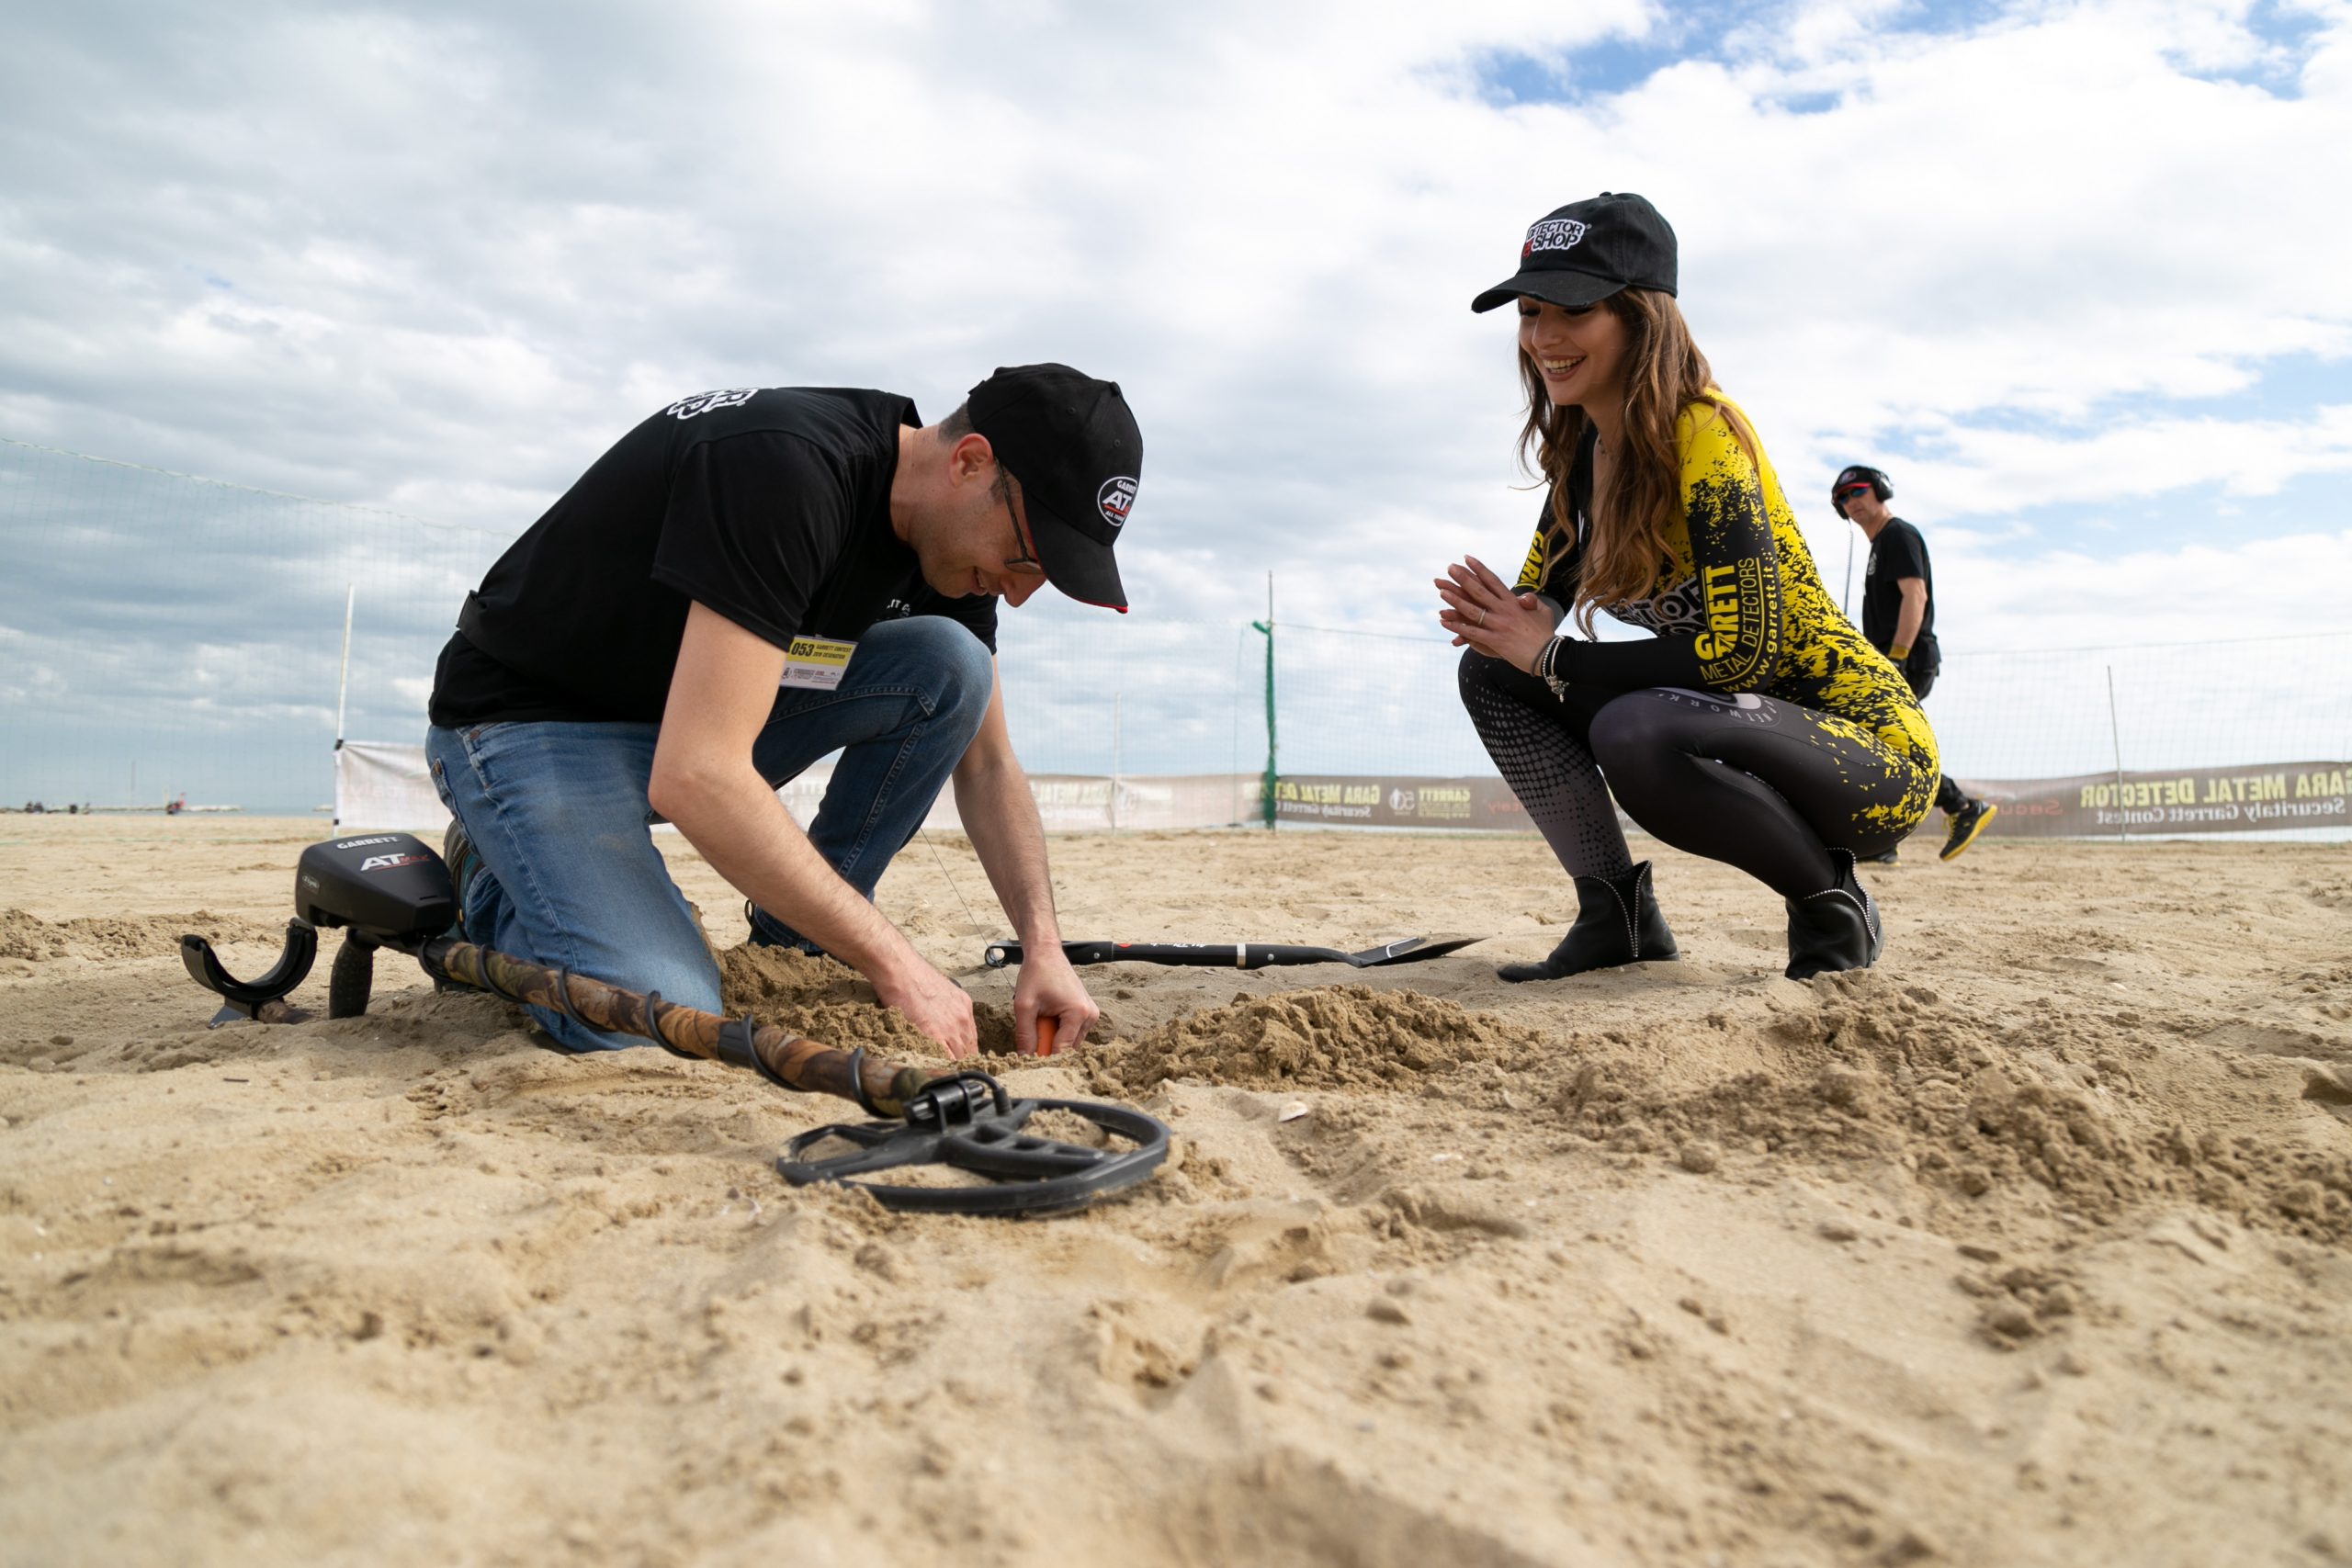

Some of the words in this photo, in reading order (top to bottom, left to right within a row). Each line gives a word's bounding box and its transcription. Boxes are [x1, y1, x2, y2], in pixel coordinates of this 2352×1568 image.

[1532, 232, 1578, 249] SHOP
[1102, 491, 1132, 511] AT
[1737, 557, 1759, 649] DETECTORS
[1723, 564, 1779, 694] www.garrett.it
[790, 642, 815, 657] 053
[1700, 654, 1753, 682] METAL
[336, 836, 399, 850] GARRETT
[360, 852, 406, 871] AT
